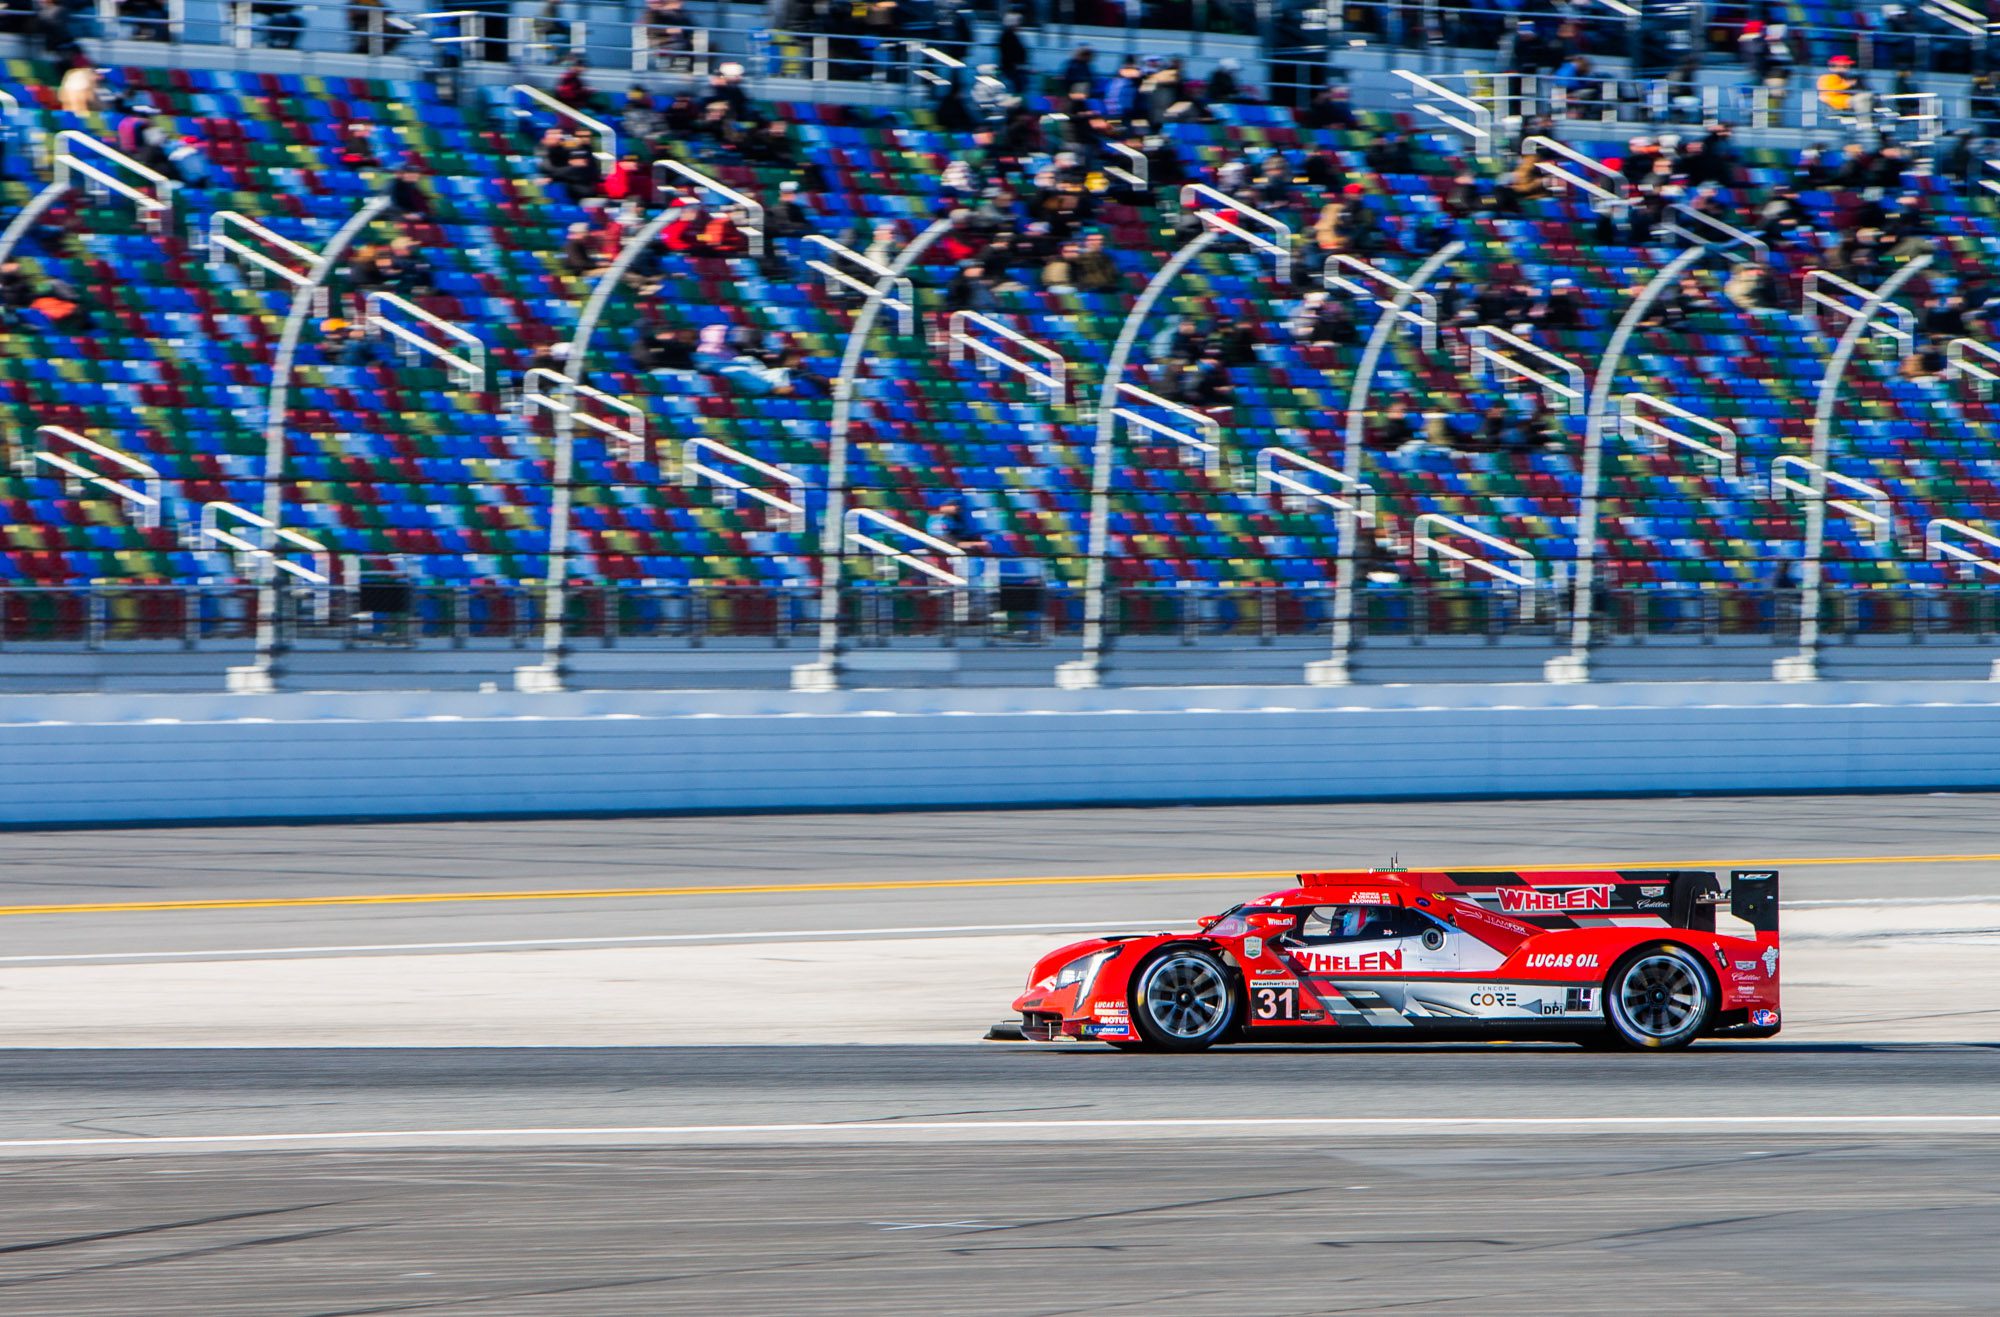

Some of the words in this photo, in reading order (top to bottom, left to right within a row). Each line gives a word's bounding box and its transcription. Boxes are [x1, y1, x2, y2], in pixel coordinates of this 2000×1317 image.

[1496, 886, 1610, 912] WHELEN
[1636, 899, 1670, 909] Cadillac
[1267, 917, 1294, 926] WHELEN
[1288, 949, 1402, 971] WHELEN
[1526, 954, 1573, 967] LUCAS
[1575, 954, 1599, 967] OIL
[1257, 988, 1293, 1019] 31
[1470, 993, 1517, 1007] CORE
[1543, 1005, 1563, 1015] DPi
[1100, 1016, 1129, 1024] MOTUL
